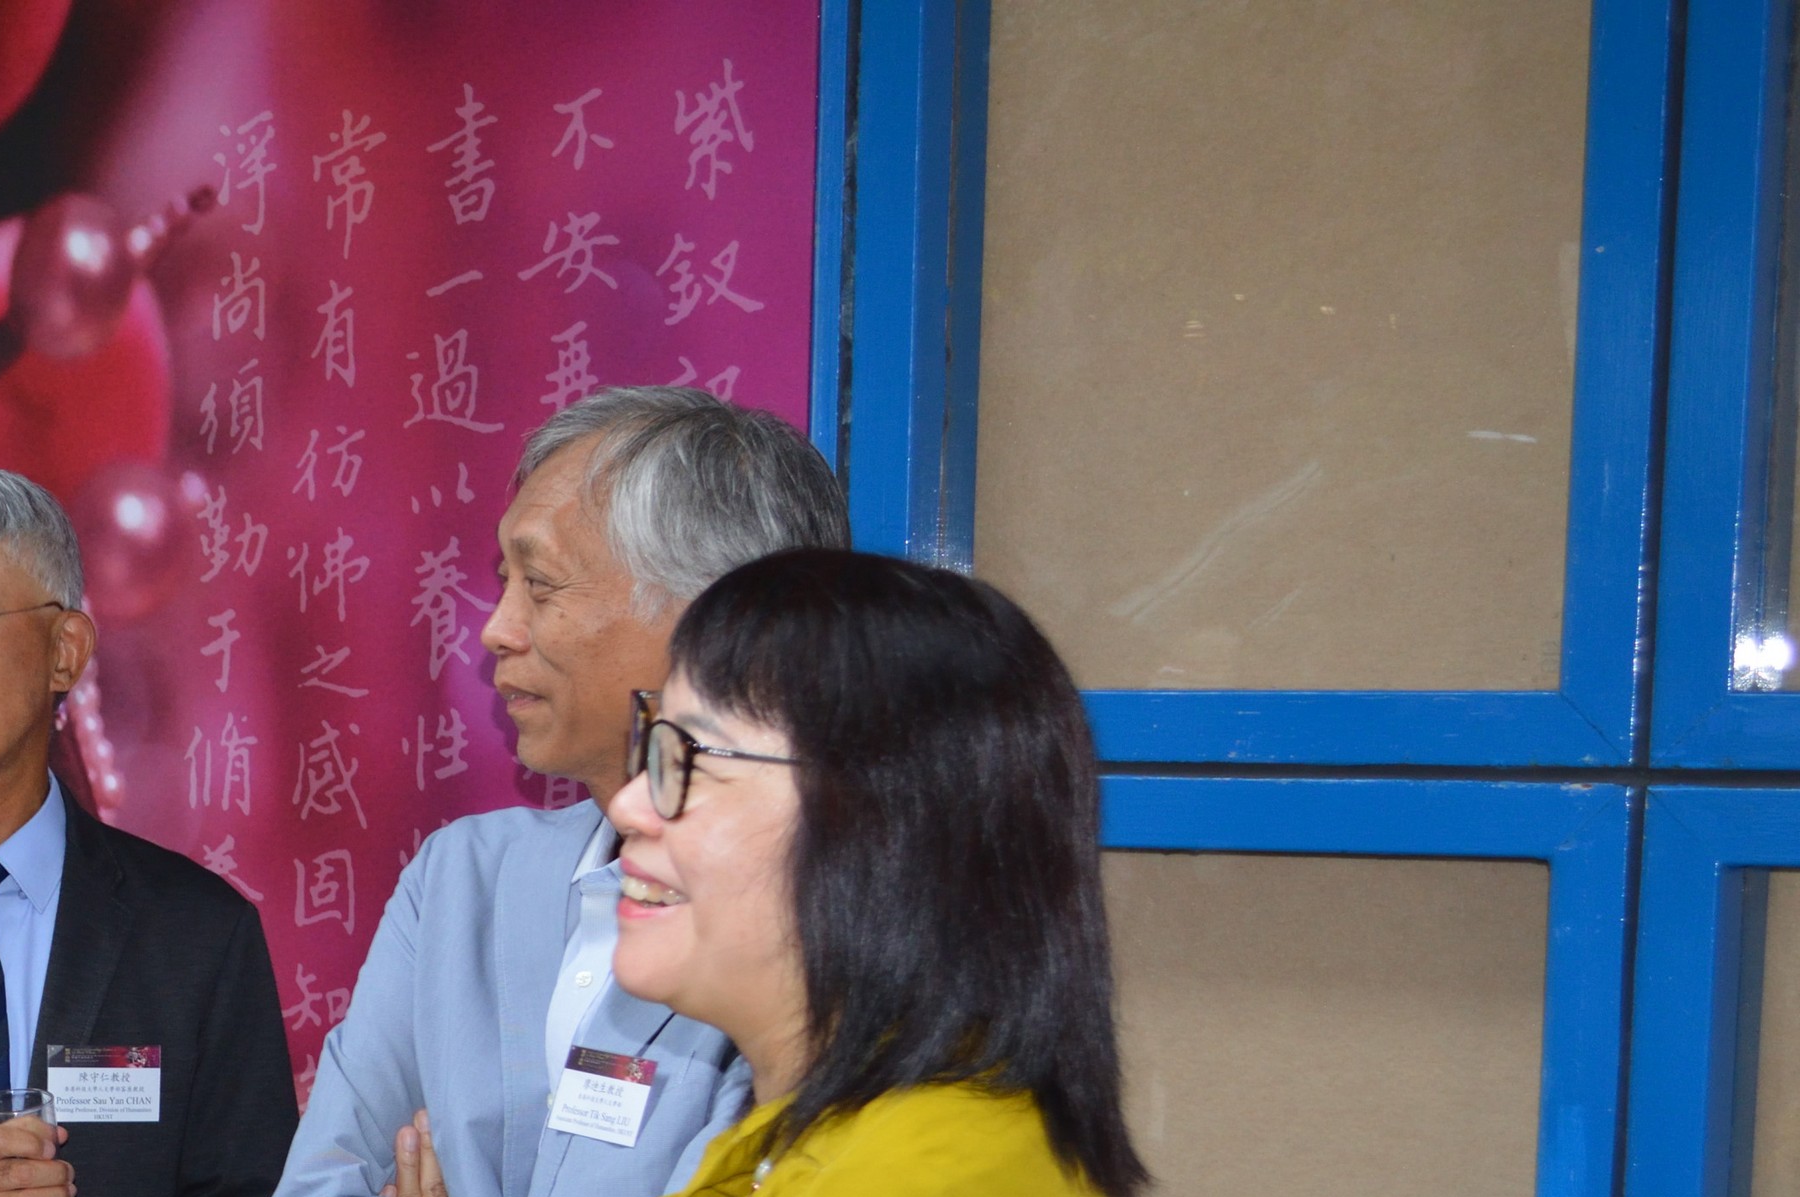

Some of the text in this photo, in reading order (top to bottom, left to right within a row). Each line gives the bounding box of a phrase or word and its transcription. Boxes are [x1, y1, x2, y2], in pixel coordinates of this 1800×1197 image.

[56, 1096, 92, 1105] Professor
[108, 1096, 125, 1105] Yan
[126, 1096, 152, 1105] CHAN
